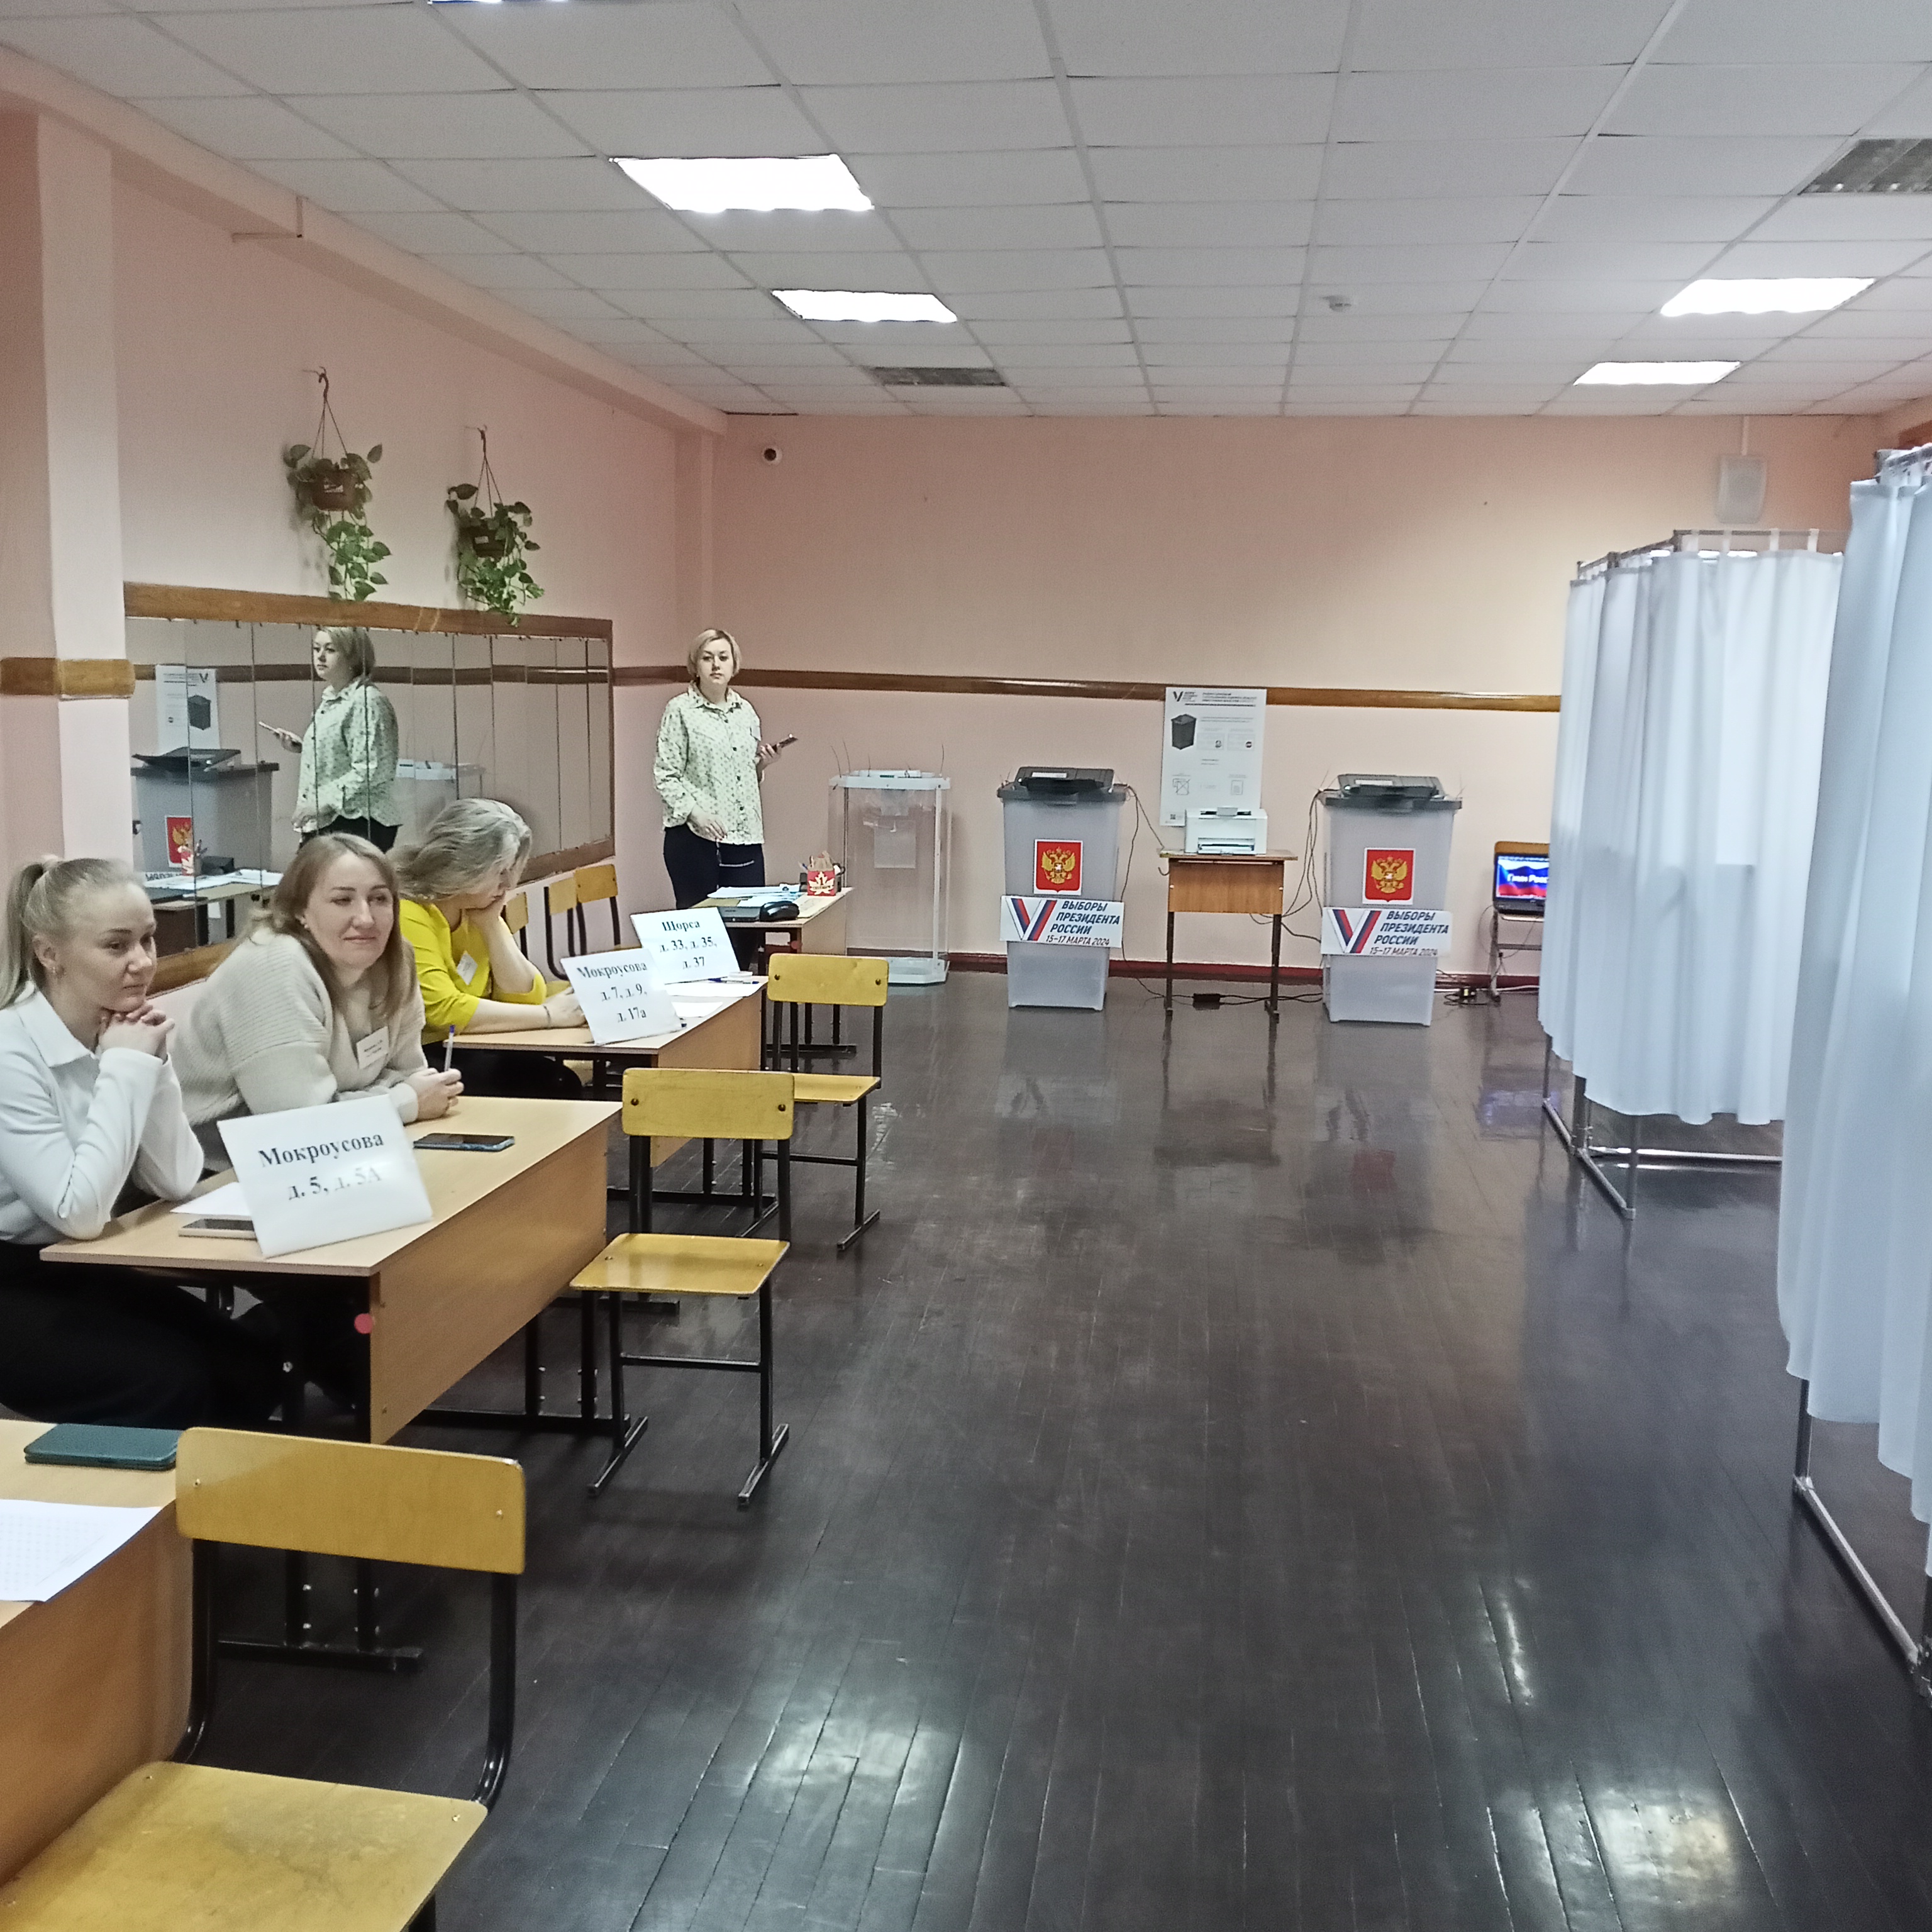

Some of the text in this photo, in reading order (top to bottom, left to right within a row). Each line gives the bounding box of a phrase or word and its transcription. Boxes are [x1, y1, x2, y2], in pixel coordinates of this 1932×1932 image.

[1062, 901, 1108, 912] ВЫБОРЫ
[1056, 912, 1120, 925] ПРЕЗИДЕНТА
[1387, 911, 1436, 921] ВЫБОРЫ
[662, 921, 700, 932] Щорса
[1050, 924, 1092, 935] РОССИИ
[1380, 923, 1449, 935] ПРЕЗИДЕНТА
[1067, 936, 1091, 945] МАРТА
[1092, 938, 1110, 946] 2024
[1374, 935, 1419, 946] РОССИИ
[693, 957, 704, 968] 37
[577, 963, 647, 979] Мокроусова
[258, 1133, 384, 1167] Мокроусова
